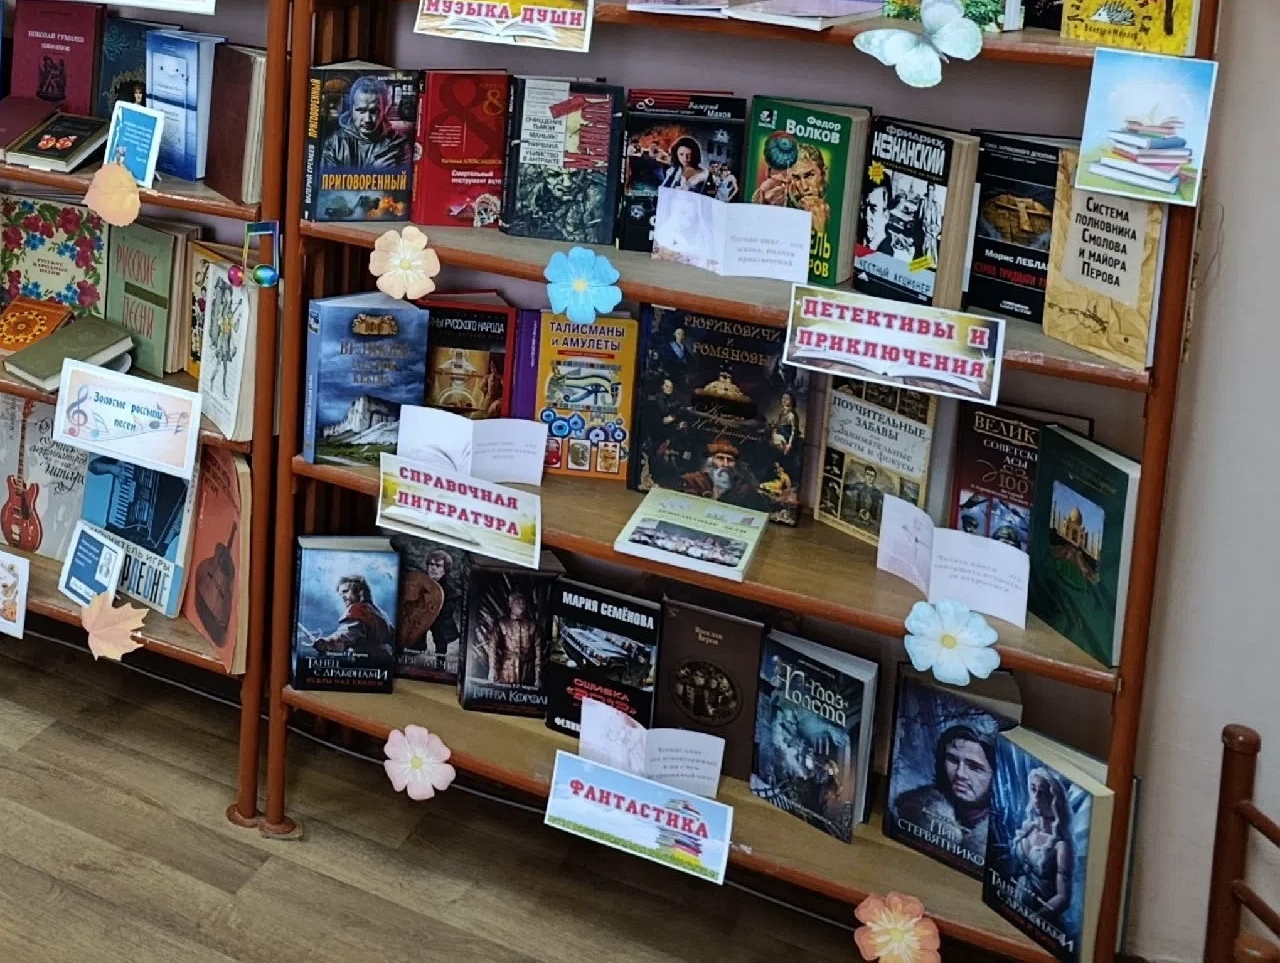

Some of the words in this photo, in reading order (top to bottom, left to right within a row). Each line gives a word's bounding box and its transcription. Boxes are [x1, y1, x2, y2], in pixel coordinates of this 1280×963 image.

[521, 7, 583, 26] ДУШИ
[307, 78, 321, 138] ПРИГОВОРЕННЫЙ
[690, 102, 718, 112] Валерий
[707, 110, 731, 118] Махов
[526, 117, 562, 126] ОЧИЩЕНИЕ
[807, 116, 841, 131] Федор
[528, 157, 560, 165] АНТРАКТЕ
[872, 131, 945, 176] НЕЗНАНСКИЙ
[322, 170, 407, 190] ПРИГОВОРЕННЫЙ
[451, 177, 486, 185] инструмент
[452, 170, 493, 178] Смертельный
[117, 243, 157, 289] РУССКИЕ
[985, 249, 1014, 262] Морис
[1015, 257, 1048, 270] ЛЕБЛА
[858, 260, 889, 277] ЧЕСТНЫЙ
[894, 273, 931, 293] АКЦИОНЕР
[122, 295, 153, 339] ПЕСНИ
[445, 319, 476, 332] РУССКОГО
[477, 322, 504, 334] НАРОДА
[803, 298, 956, 341] ДЕТЕКТИВЫ
[971, 327, 988, 345] И
[549, 321, 625, 338] ТАЛИСМАНЫ
[684, 316, 780, 342] РЮРИКОВИЧИ
[562, 337, 620, 351] АМУЛЕТЫ
[798, 329, 986, 379] ПРИКЛЮЧЕНИЯ
[93, 391, 126, 409] Золотые
[833, 396, 926, 439] ПОУЧИТЕЛЬНЫЕ
[855, 417, 898, 441] ЗАБАВЫ
[833, 423, 912, 462] Занимательные
[834, 436, 864, 452] опыты
[876, 450, 915, 472] фокусы
[1003, 455, 1028, 469] АСЫ
[399, 467, 518, 510] СПРАВОЧНАЯ
[998, 473, 1029, 494] 100
[398, 491, 519, 536] ЛИТЕРАТУРА
[146, 551, 170, 571] ИГРЫ
[562, 591, 599, 613] МАРИЯ
[601, 602, 654, 630] СЕМЁНОВА
[306, 657, 339, 669] ТАНЕЦ
[322, 668, 388, 680] ДРАКОНАМИ
[569, 778, 709, 839] ФАНТАСТИКА
